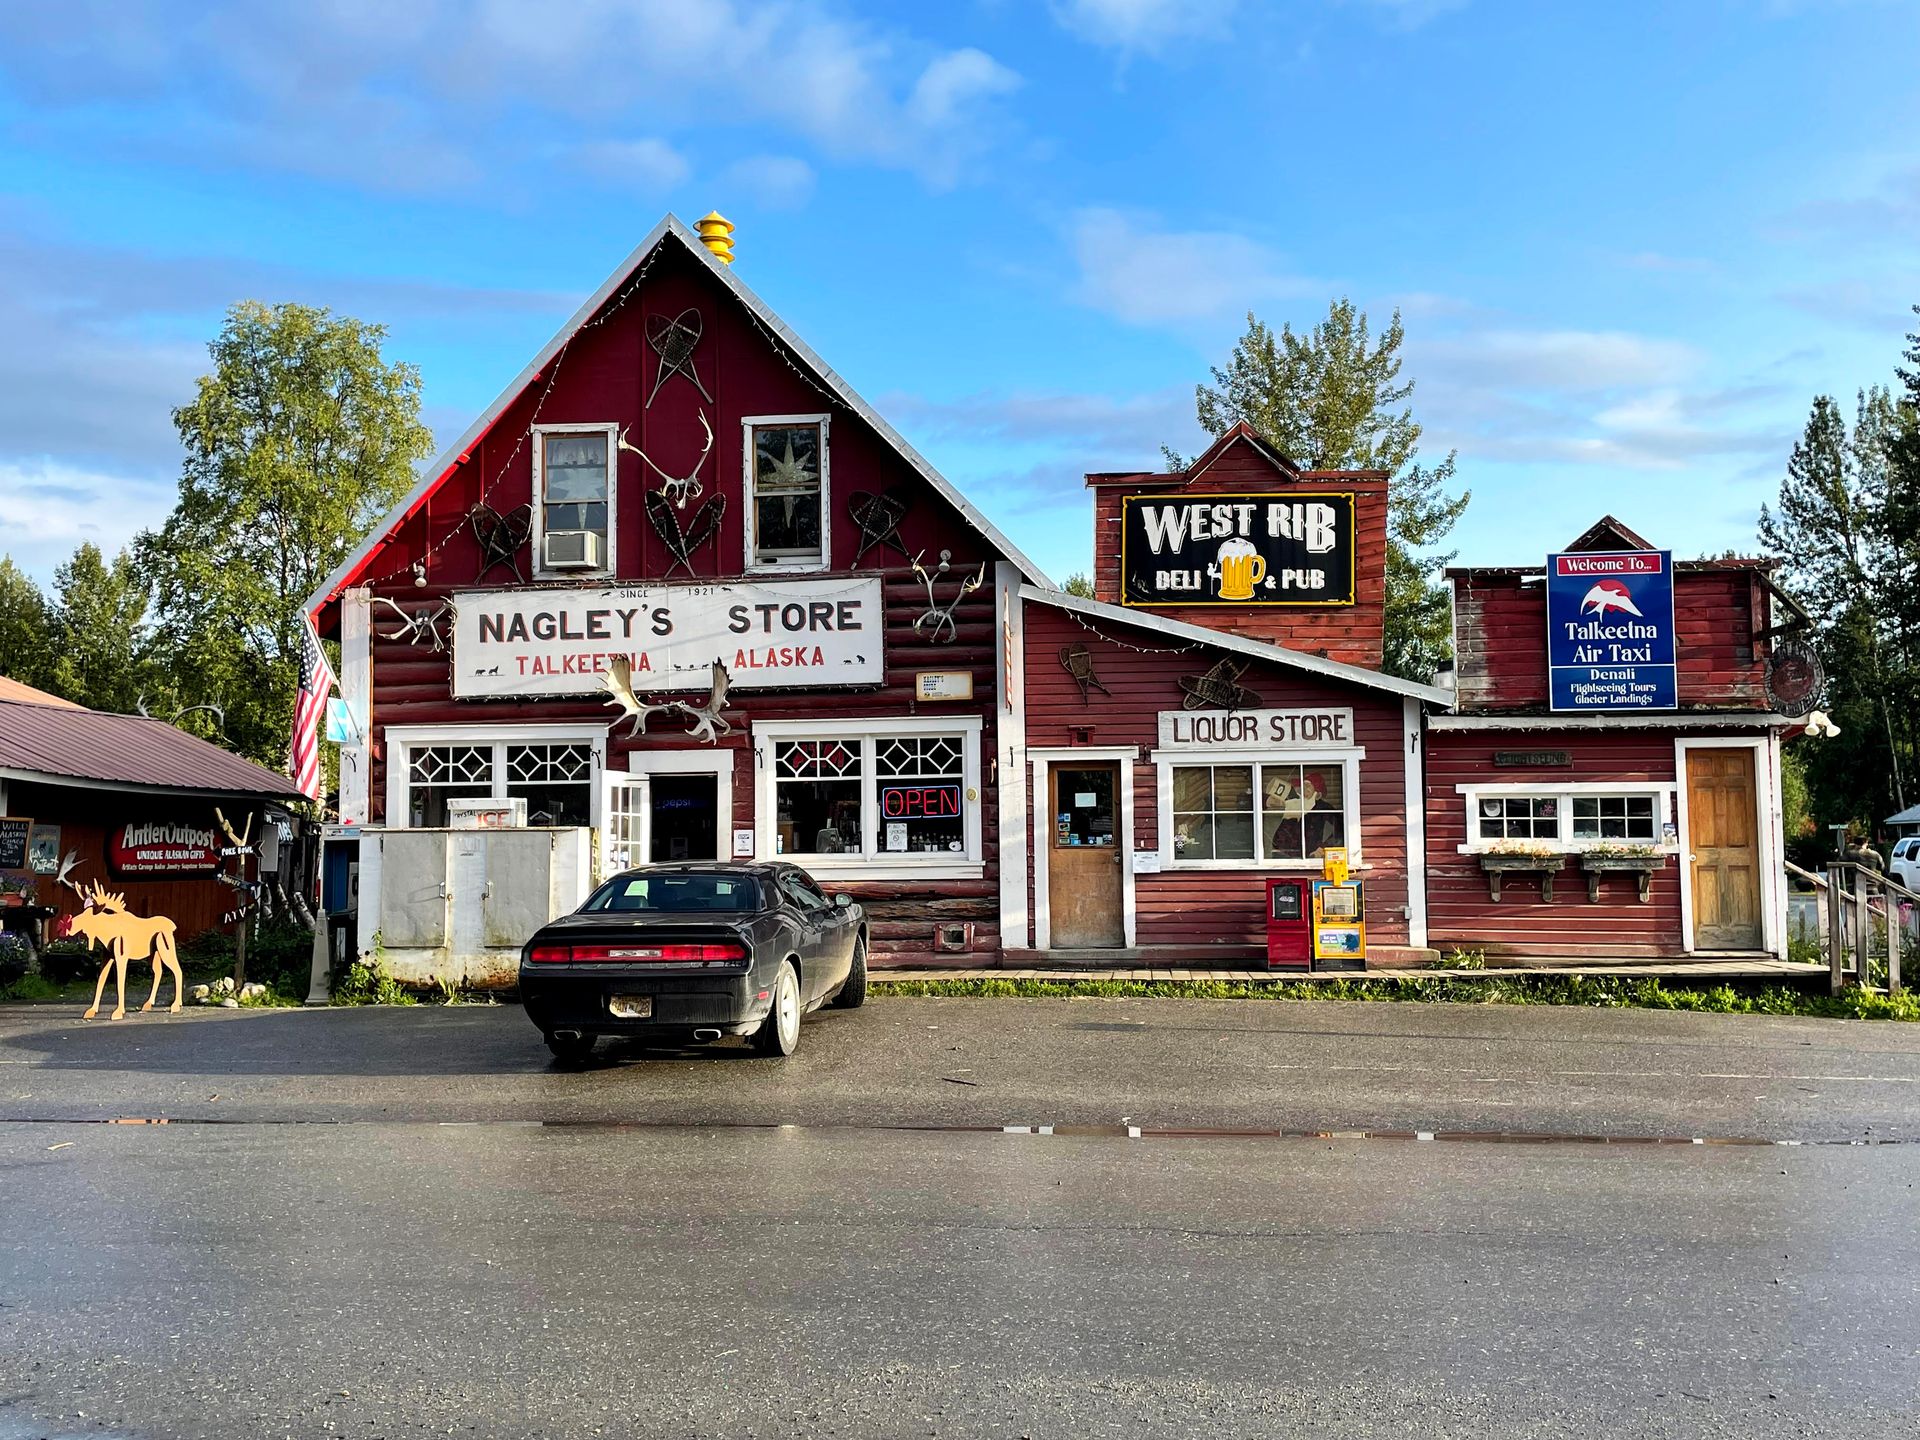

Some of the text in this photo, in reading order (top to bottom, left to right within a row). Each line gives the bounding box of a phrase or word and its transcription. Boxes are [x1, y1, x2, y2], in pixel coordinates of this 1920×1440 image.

[1141, 502, 1336, 555] WEST RIB
[1566, 557, 1652, 571] Welcome To...
[1155, 569, 1325, 590] DELI & PUB
[620, 587, 714, 599] SINCE 1921
[479, 600, 863, 643] NAGLEY'S STORE
[1565, 620, 1658, 641] Talkeetna
[734, 646, 825, 669] ALASKA
[1572, 643, 1652, 663] Air Taxi
[1590, 667, 1636, 681] Denali
[1570, 682, 1657, 695] Flightseeing Tours
[1575, 693, 1653, 706] Glacier Landings
[1173, 714, 1348, 744] LIQUOR STORE
[885, 789, 958, 816] OPEN
[2, 821, 29, 830] WILD
[136, 850, 206, 860] UNIQUE ALASKAN GIFTS
